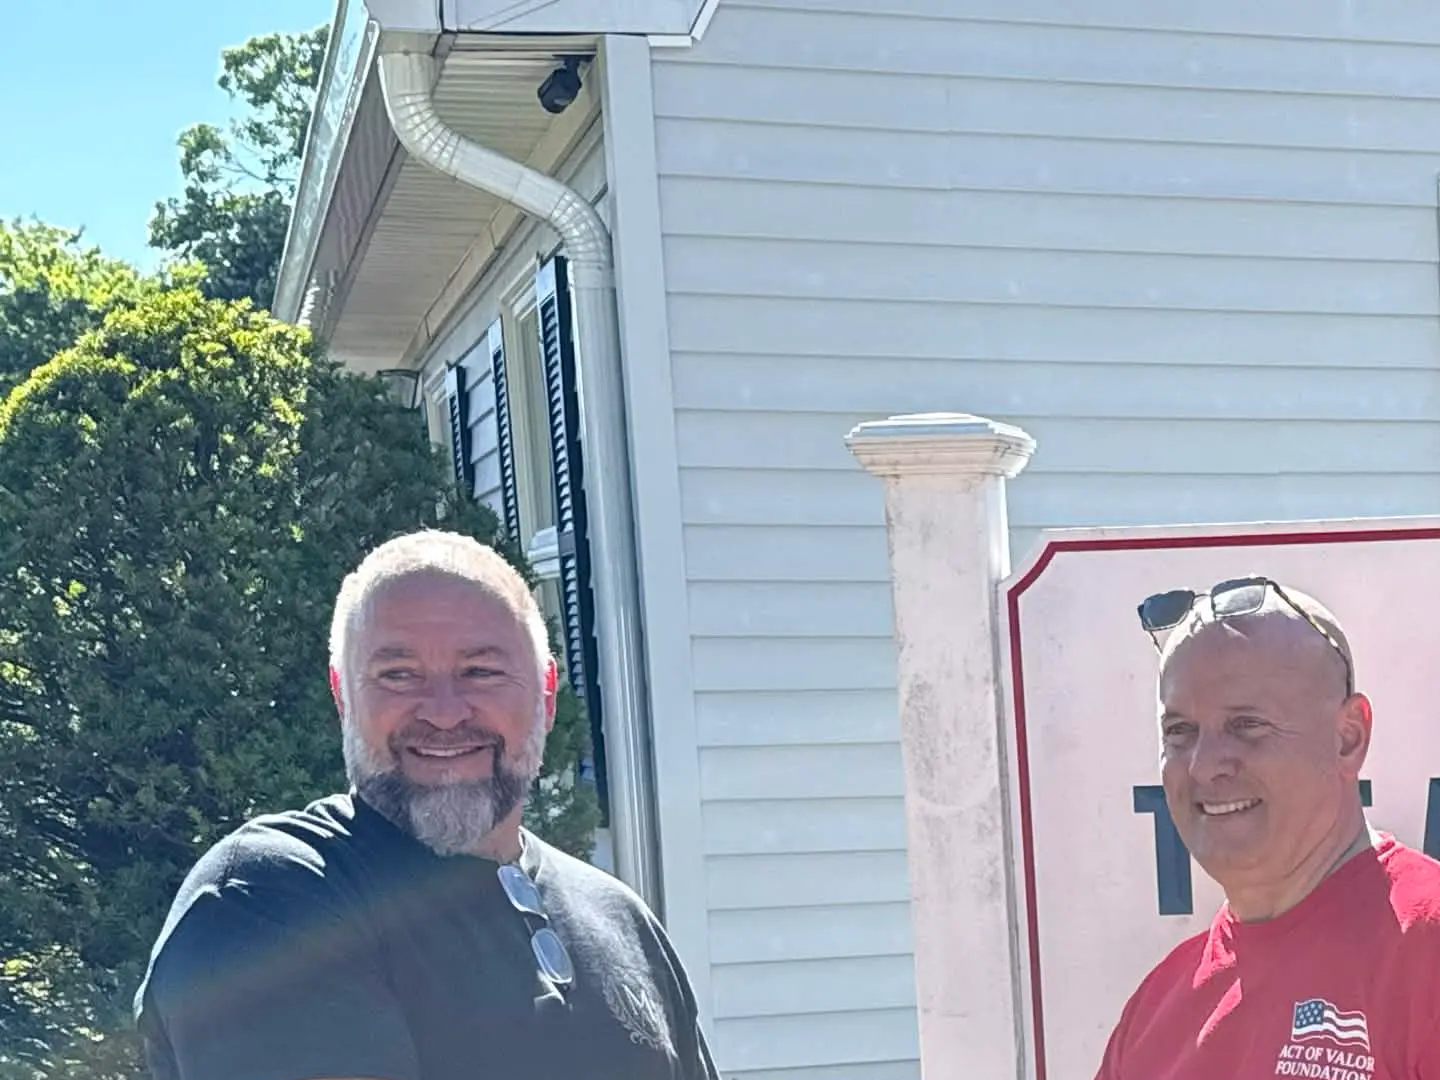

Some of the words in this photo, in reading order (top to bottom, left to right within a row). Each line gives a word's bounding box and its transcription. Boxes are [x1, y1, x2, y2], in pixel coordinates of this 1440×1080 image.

[1278, 1044, 1305, 1060] ACT
[1305, 1045, 1325, 1061] OF
[1325, 1048, 1375, 1072] VALOR
